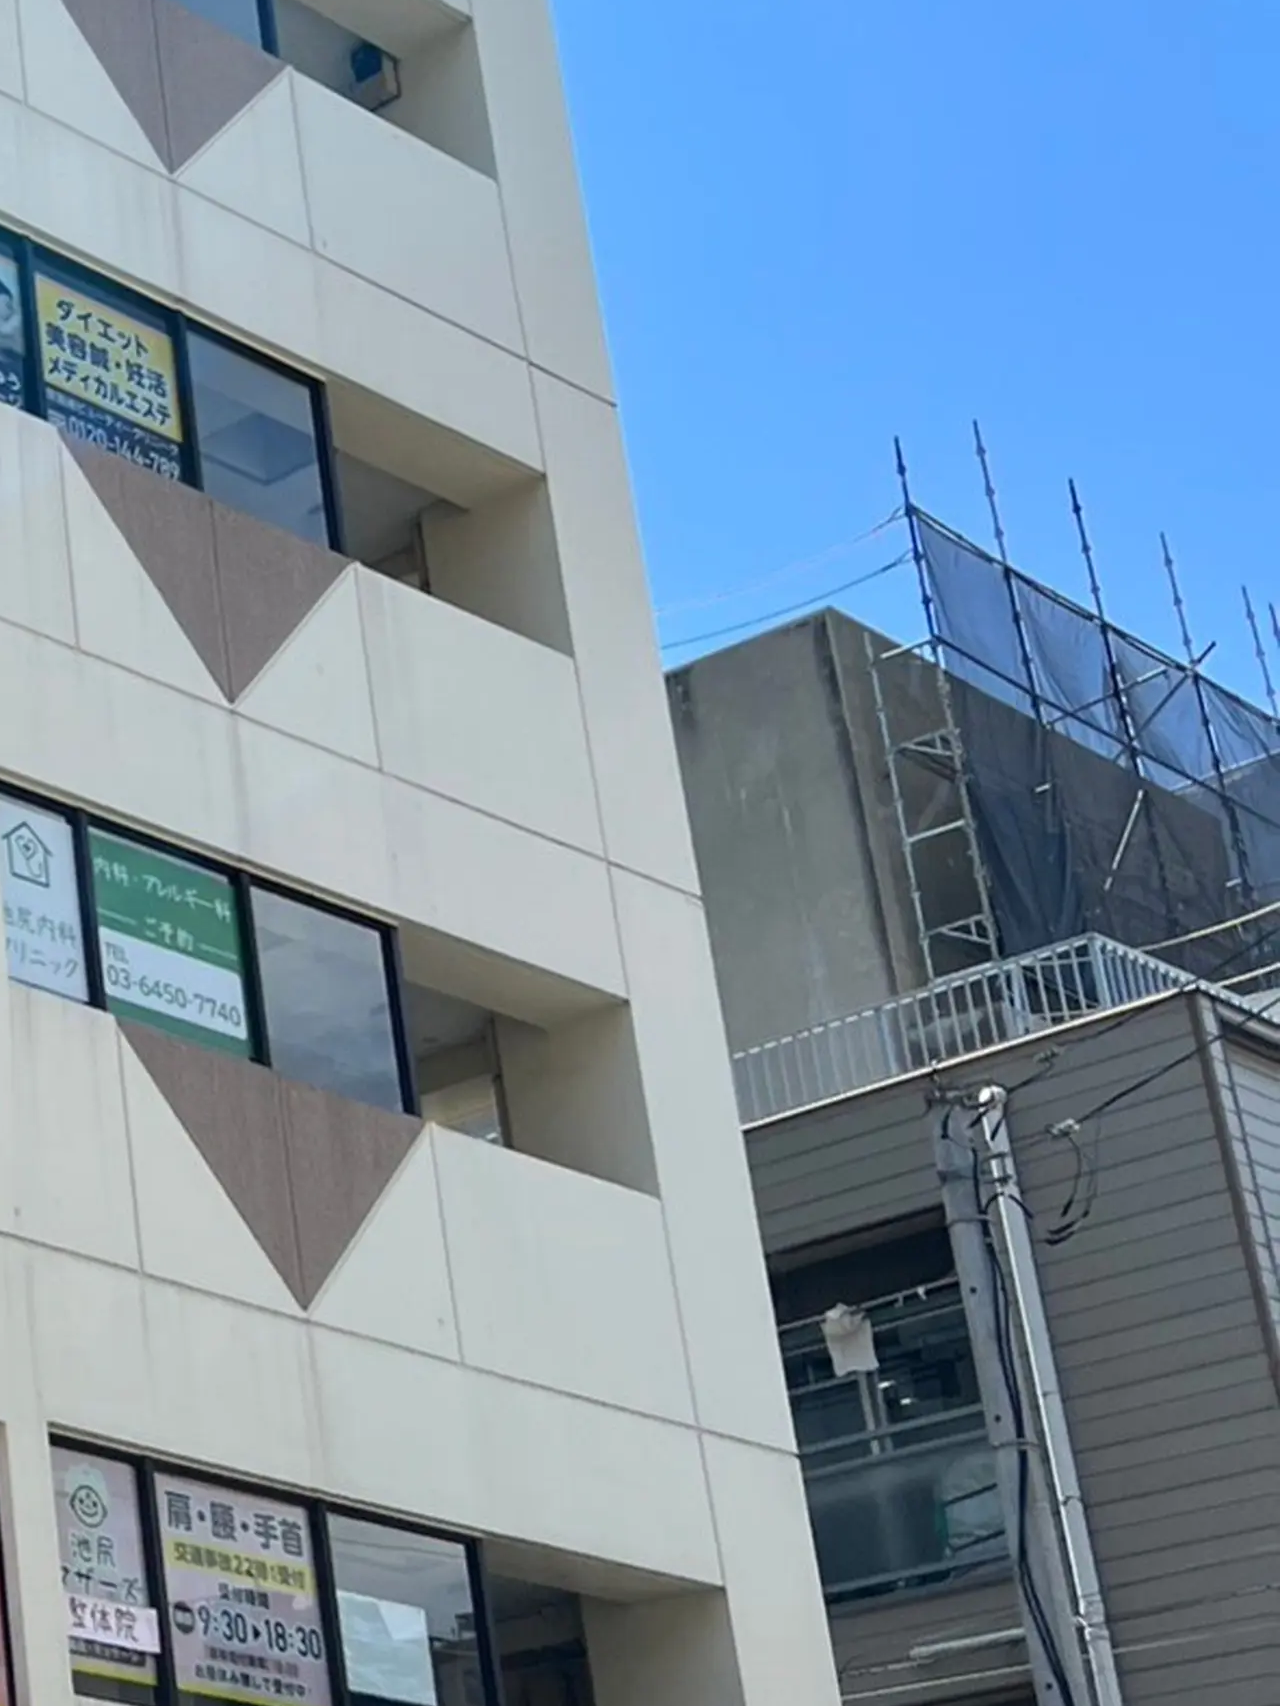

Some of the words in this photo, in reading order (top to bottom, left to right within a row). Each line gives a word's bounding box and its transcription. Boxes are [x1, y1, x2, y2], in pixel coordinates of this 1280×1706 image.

[56, 299, 150, 358] ダイエット
[48, 356, 172, 427] メディカルエステ
[92, 855, 232, 924] 内科・アレルギー科
[105, 941, 129, 965] TEL
[143, 916, 195, 952] ご予約
[106, 964, 242, 1027] 03-6450-7740
[70, 1533, 116, 1568] 池尻
[164, 1489, 304, 1558] 肩・腰・手首
[197, 1605, 249, 1644] 9:30
[263, 1618, 322, 1660] 18:30
